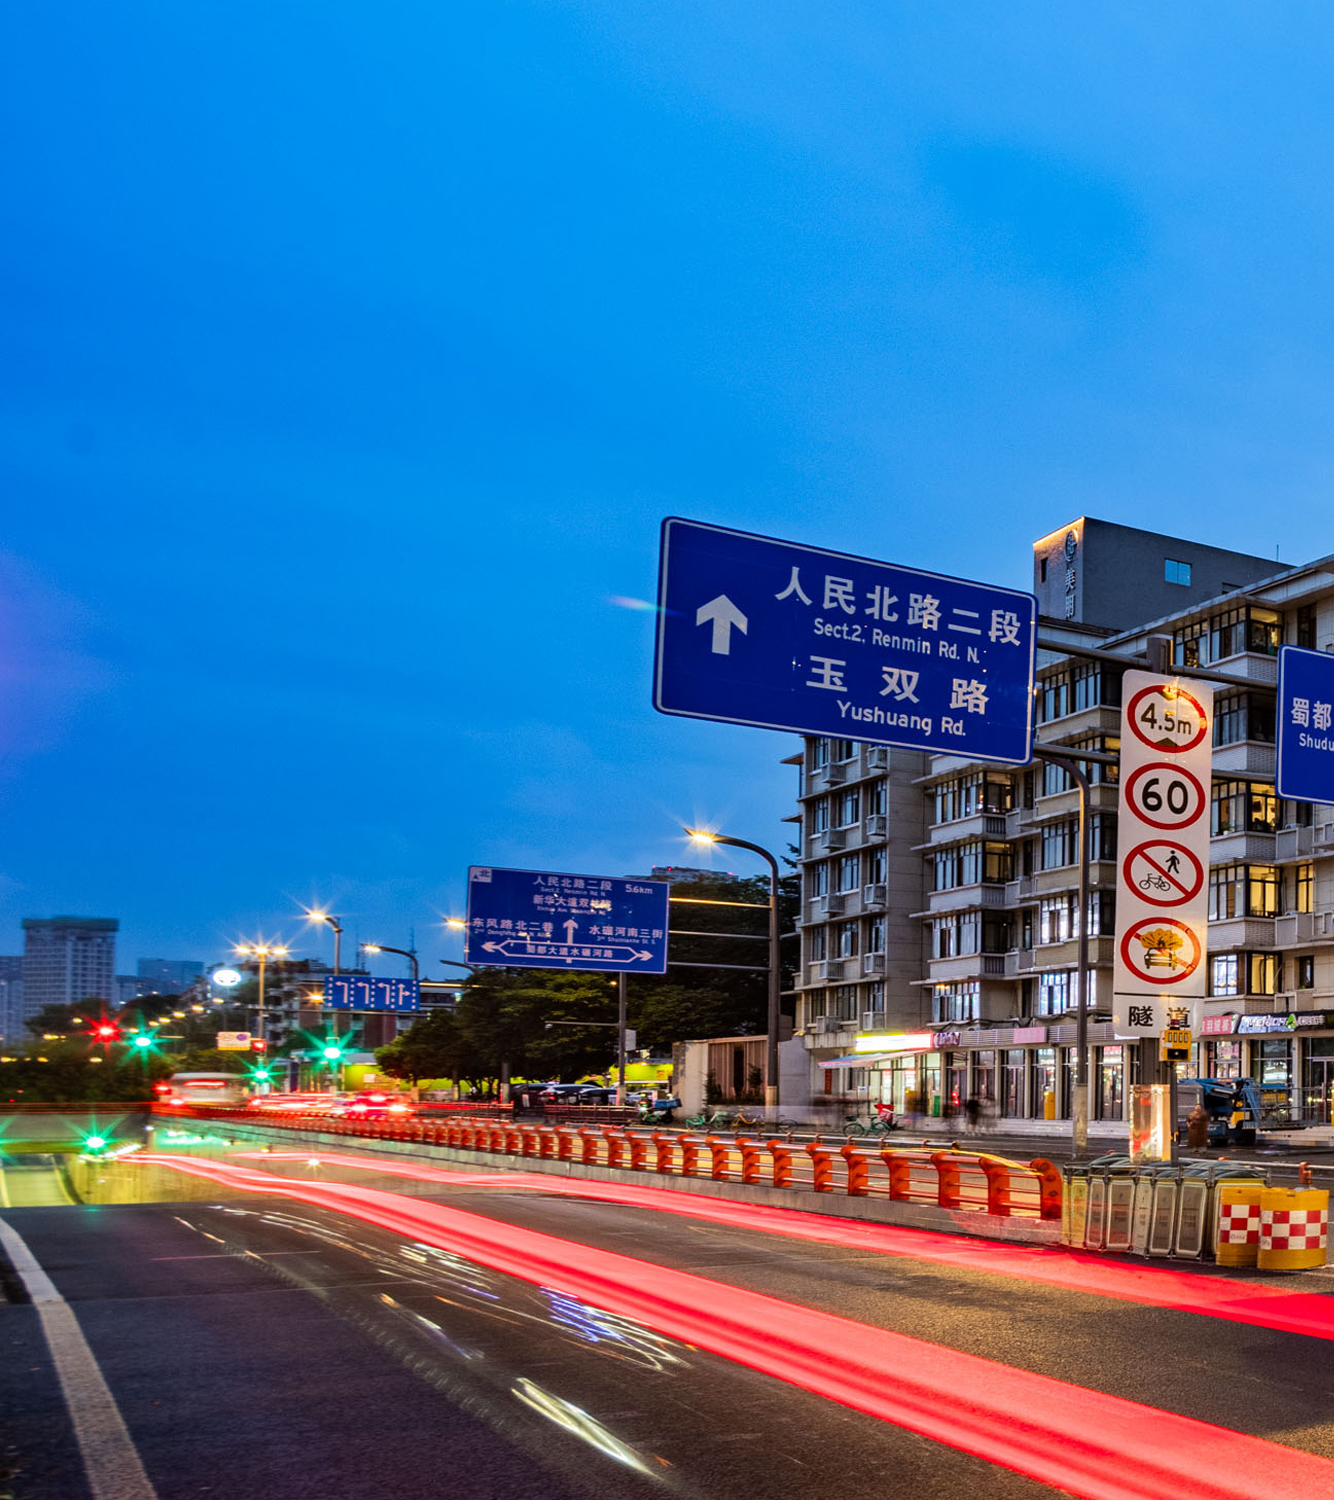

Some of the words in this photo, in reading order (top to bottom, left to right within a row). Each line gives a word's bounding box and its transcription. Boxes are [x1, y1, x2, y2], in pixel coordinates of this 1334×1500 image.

[775, 567, 1021, 647] 人民北路二段
[872, 629, 931, 655] Renmin
[938, 640, 960, 661] Rd.
[967, 646, 980, 664] N.
[806, 655, 989, 715] 玉双路
[837, 700, 932, 736] Yushuang
[941, 717, 967, 737] Rd.
[1141, 702, 1192, 736] 4.5m
[1142, 778, 1188, 815] 60
[533, 875, 613, 891] 人民北路二段
[1128, 1006, 1191, 1029] 隧道
